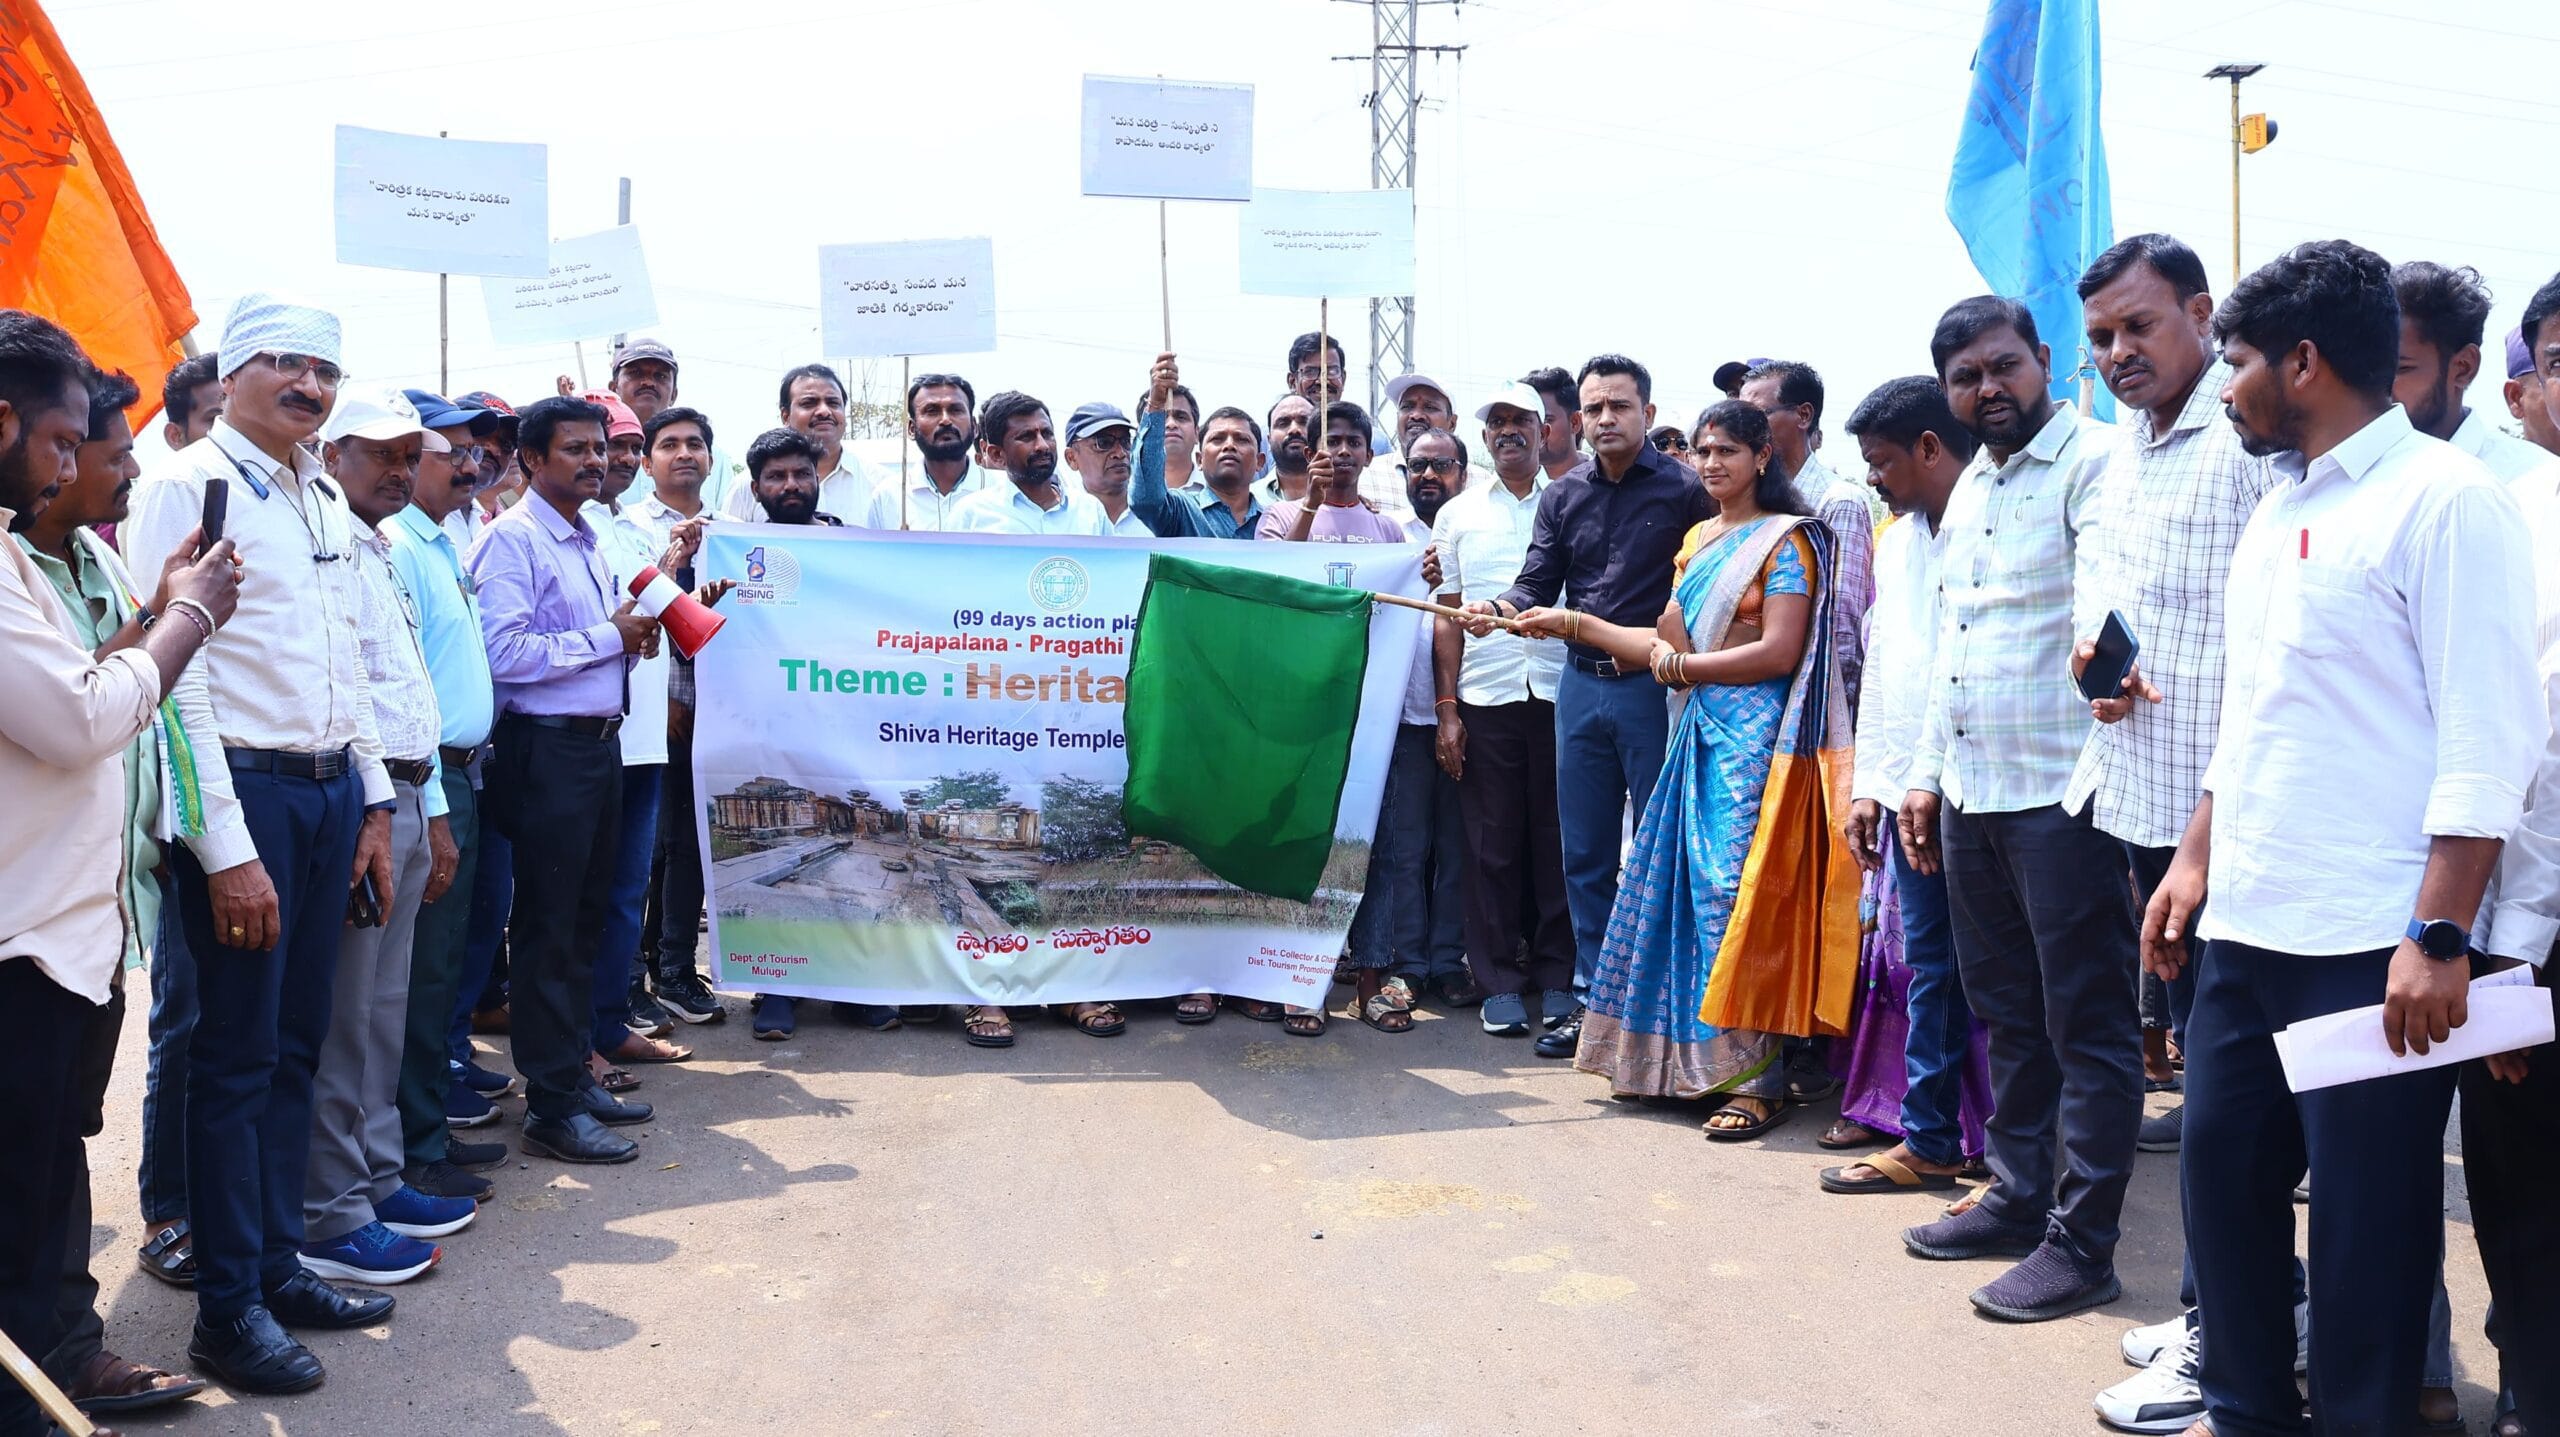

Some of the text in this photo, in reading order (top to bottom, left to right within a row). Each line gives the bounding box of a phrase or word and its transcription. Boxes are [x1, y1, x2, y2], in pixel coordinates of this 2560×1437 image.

[407, 207, 430, 219] మన
[844, 276, 967, 295] "వారసత్వ సంపద మన
[857, 303, 886, 315] జాతికి
[1312, 534, 1374, 544] FUN BOY
[737, 581, 774, 589] TELANGANA
[737, 589, 774, 600] RISING
[953, 609, 984, 629] (99
[990, 610, 1036, 631] days
[1042, 612, 1105, 630] action
[877, 630, 1008, 654] Prajapalana
[1029, 635, 1124, 659] Pragathi
[779, 659, 928, 696] Theme
[879, 722, 1125, 752] Shiva Heritage Temple
[956, 931, 1029, 960] స్వాగతం
[1052, 926, 1151, 955] సుస్వాగతం
[730, 952, 808, 965] Dept. of Tourism
[1260, 947, 1278, 957] Dist.
[1280, 949, 1314, 961] Collector
[1314, 954, 1320, 962] &
[1247, 956, 1266, 967] Dist.
[1268, 959, 1298, 971] Tourism
[751, 966, 787, 978] Mulugu
[1292, 974, 1316, 986] Mulugu
